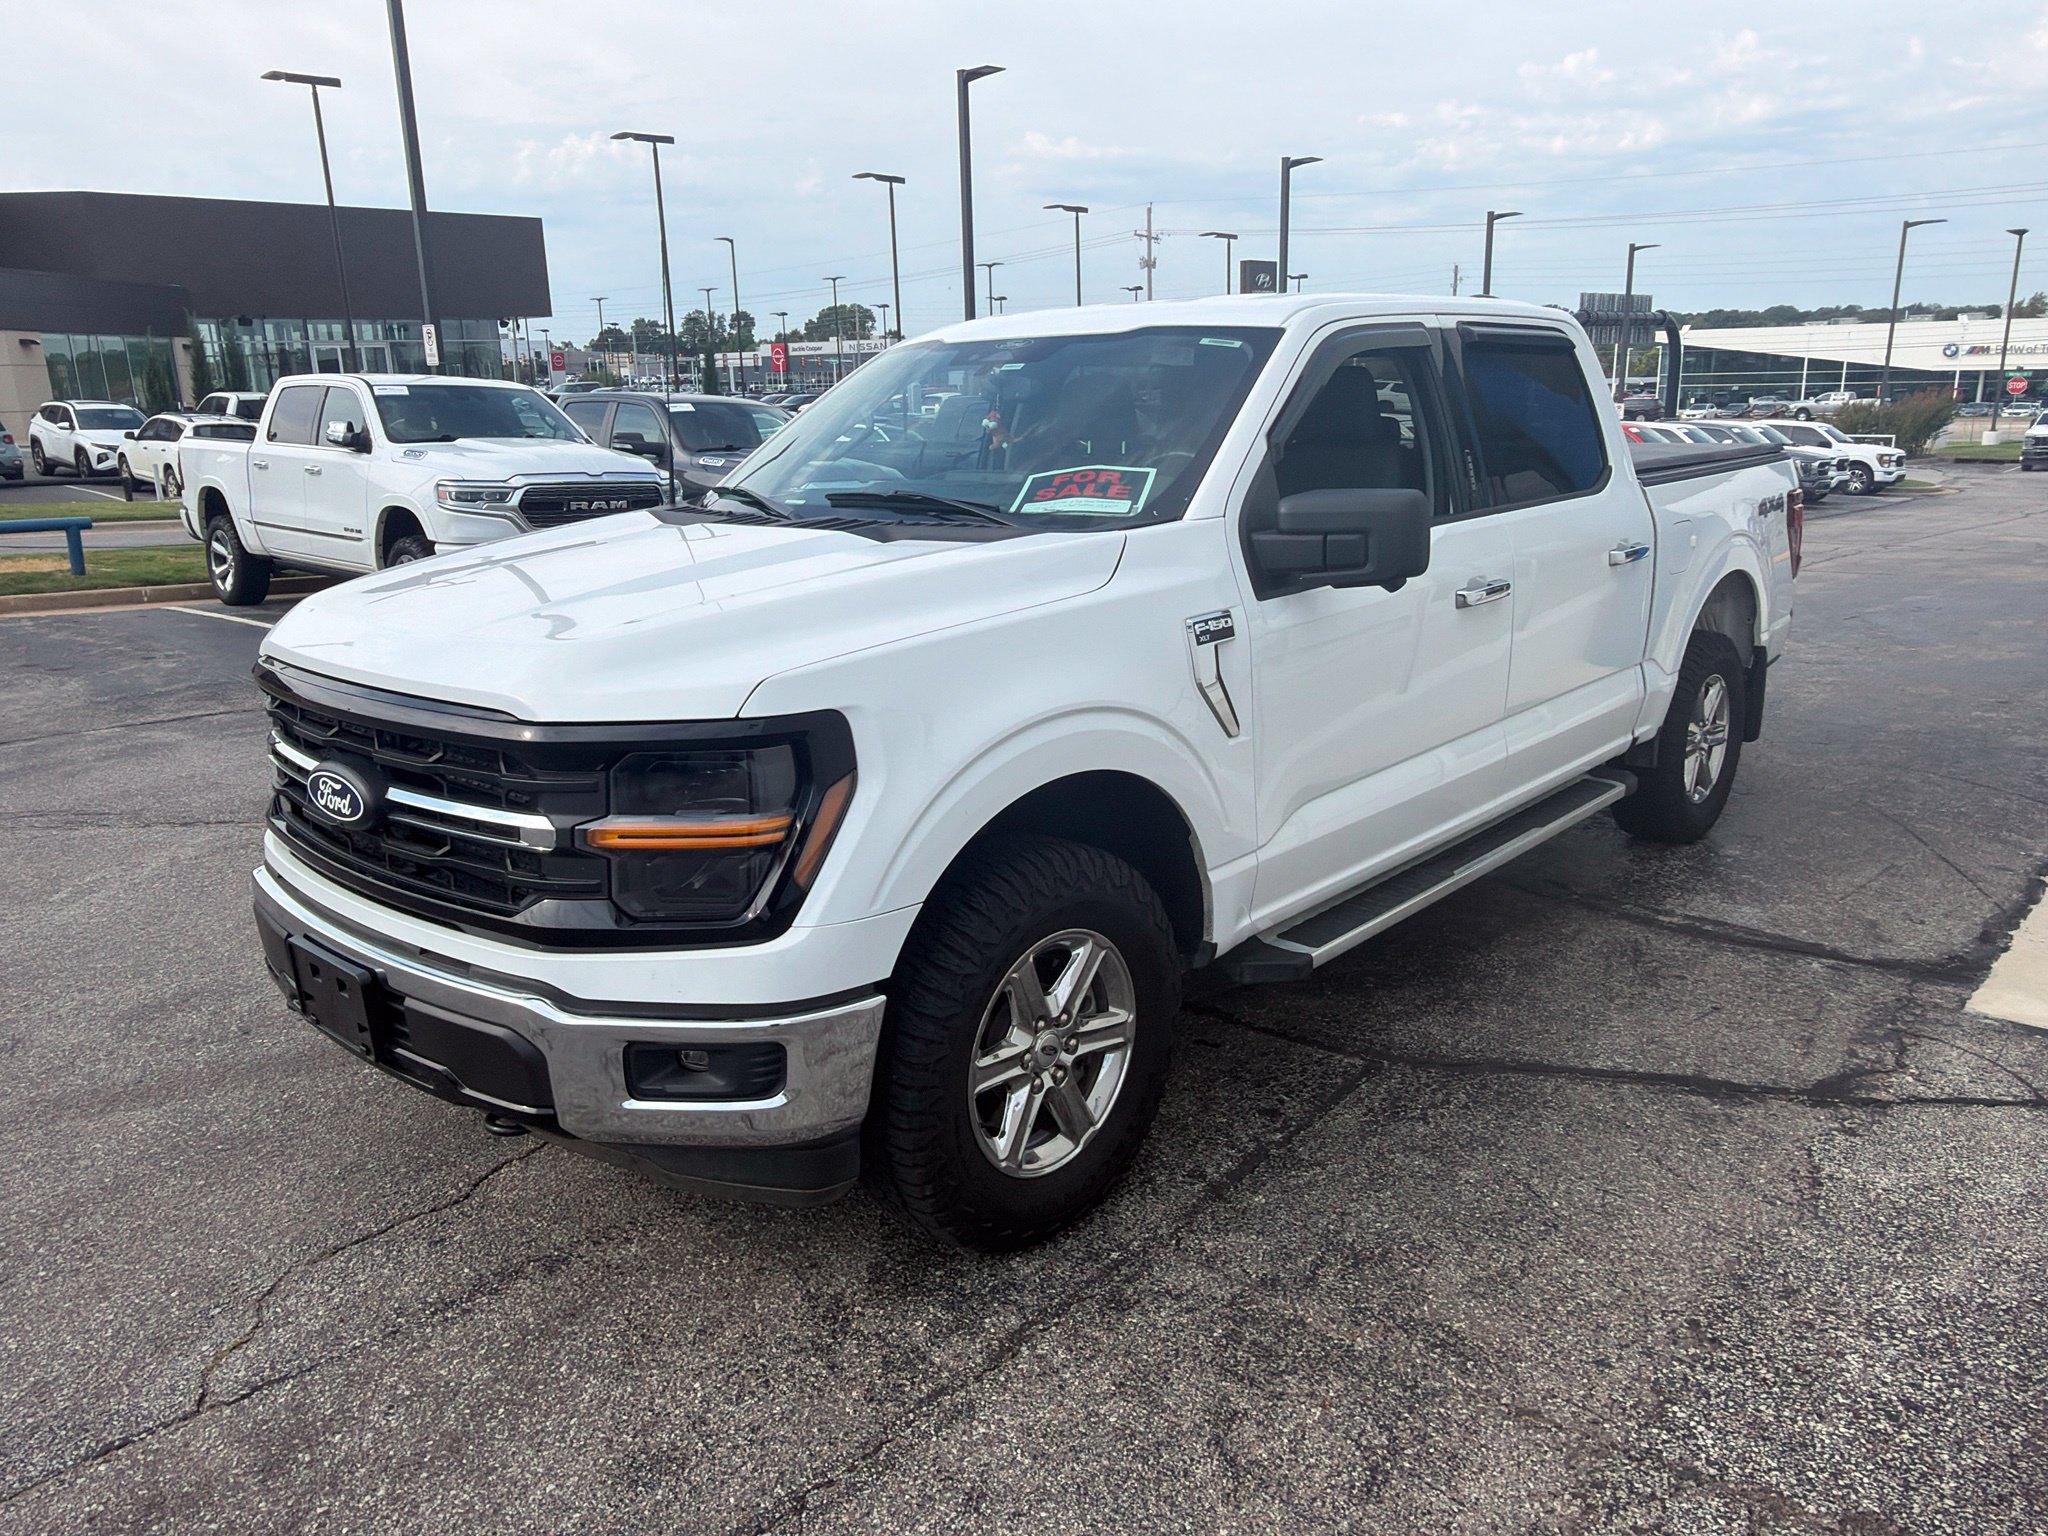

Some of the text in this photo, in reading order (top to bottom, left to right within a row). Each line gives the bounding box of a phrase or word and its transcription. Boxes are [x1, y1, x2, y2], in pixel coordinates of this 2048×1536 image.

[2026, 344, 2038, 354] of
[2008, 381, 2026, 389] STOP
[1052, 469, 1122, 487] FOR
[1033, 483, 1133, 501] SALE
[569, 500, 628, 511] RAM
[1194, 617, 1233, 635] F-150
[1199, 634, 1211, 643] XLT
[317, 776, 352, 815] Ford
